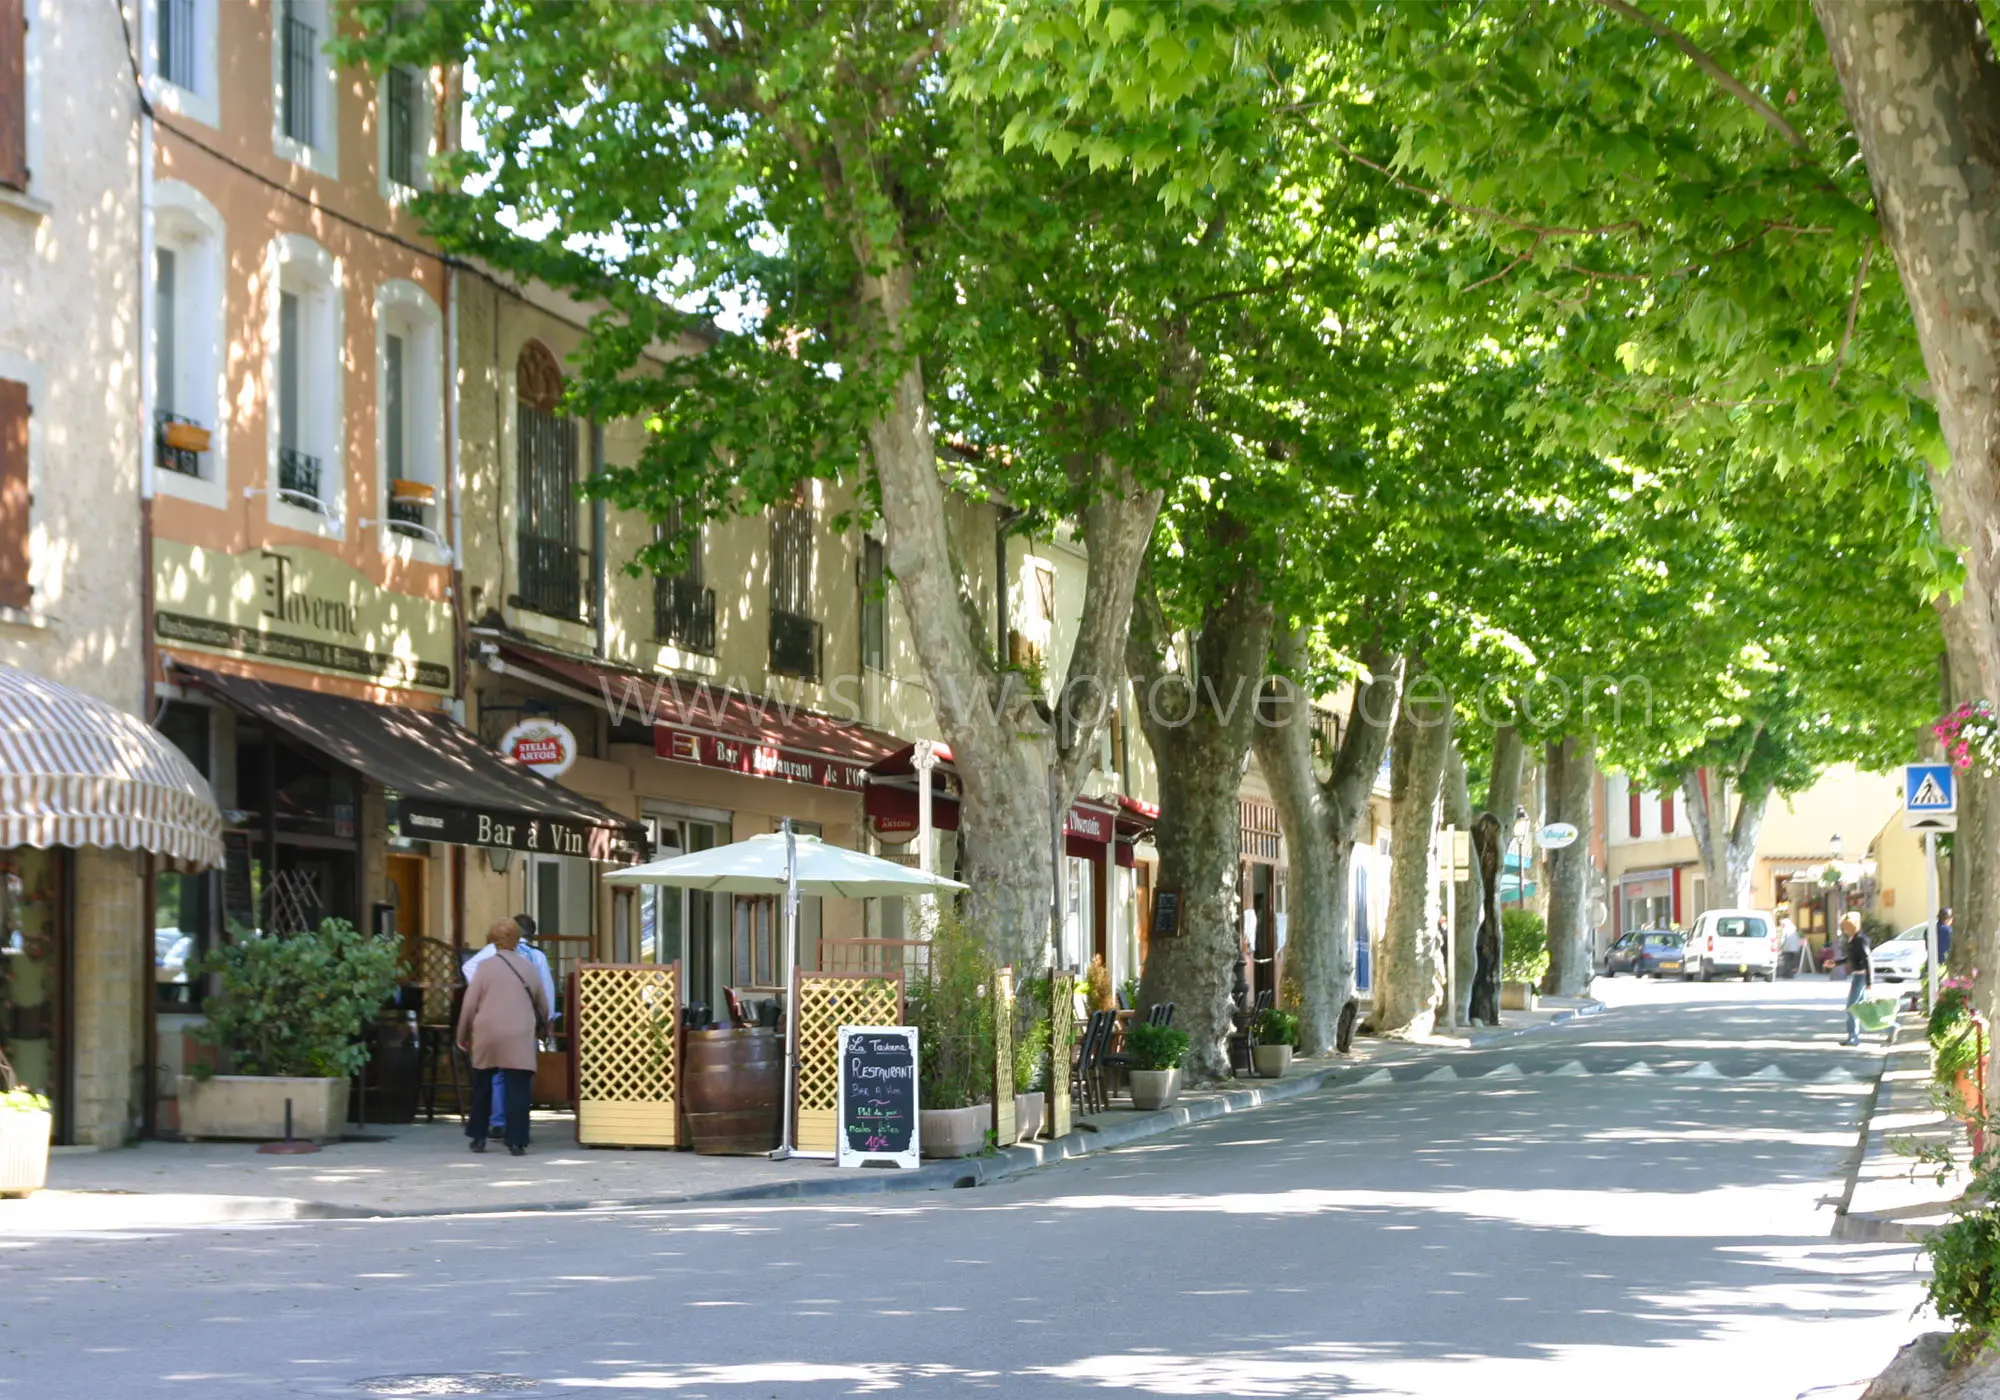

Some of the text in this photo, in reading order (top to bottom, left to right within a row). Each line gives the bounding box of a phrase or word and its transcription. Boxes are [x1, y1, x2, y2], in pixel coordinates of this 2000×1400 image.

[261, 550, 359, 637] Taverne
[519, 742, 557, 751] STELLA
[519, 751, 557, 761] ARTOIS
[716, 740, 738, 764] Bar
[825, 763, 838, 783] de
[477, 814, 516, 846] Bar
[527, 820, 539, 849] à
[550, 824, 583, 853] Vin
[848, 1035, 867, 1052] La
